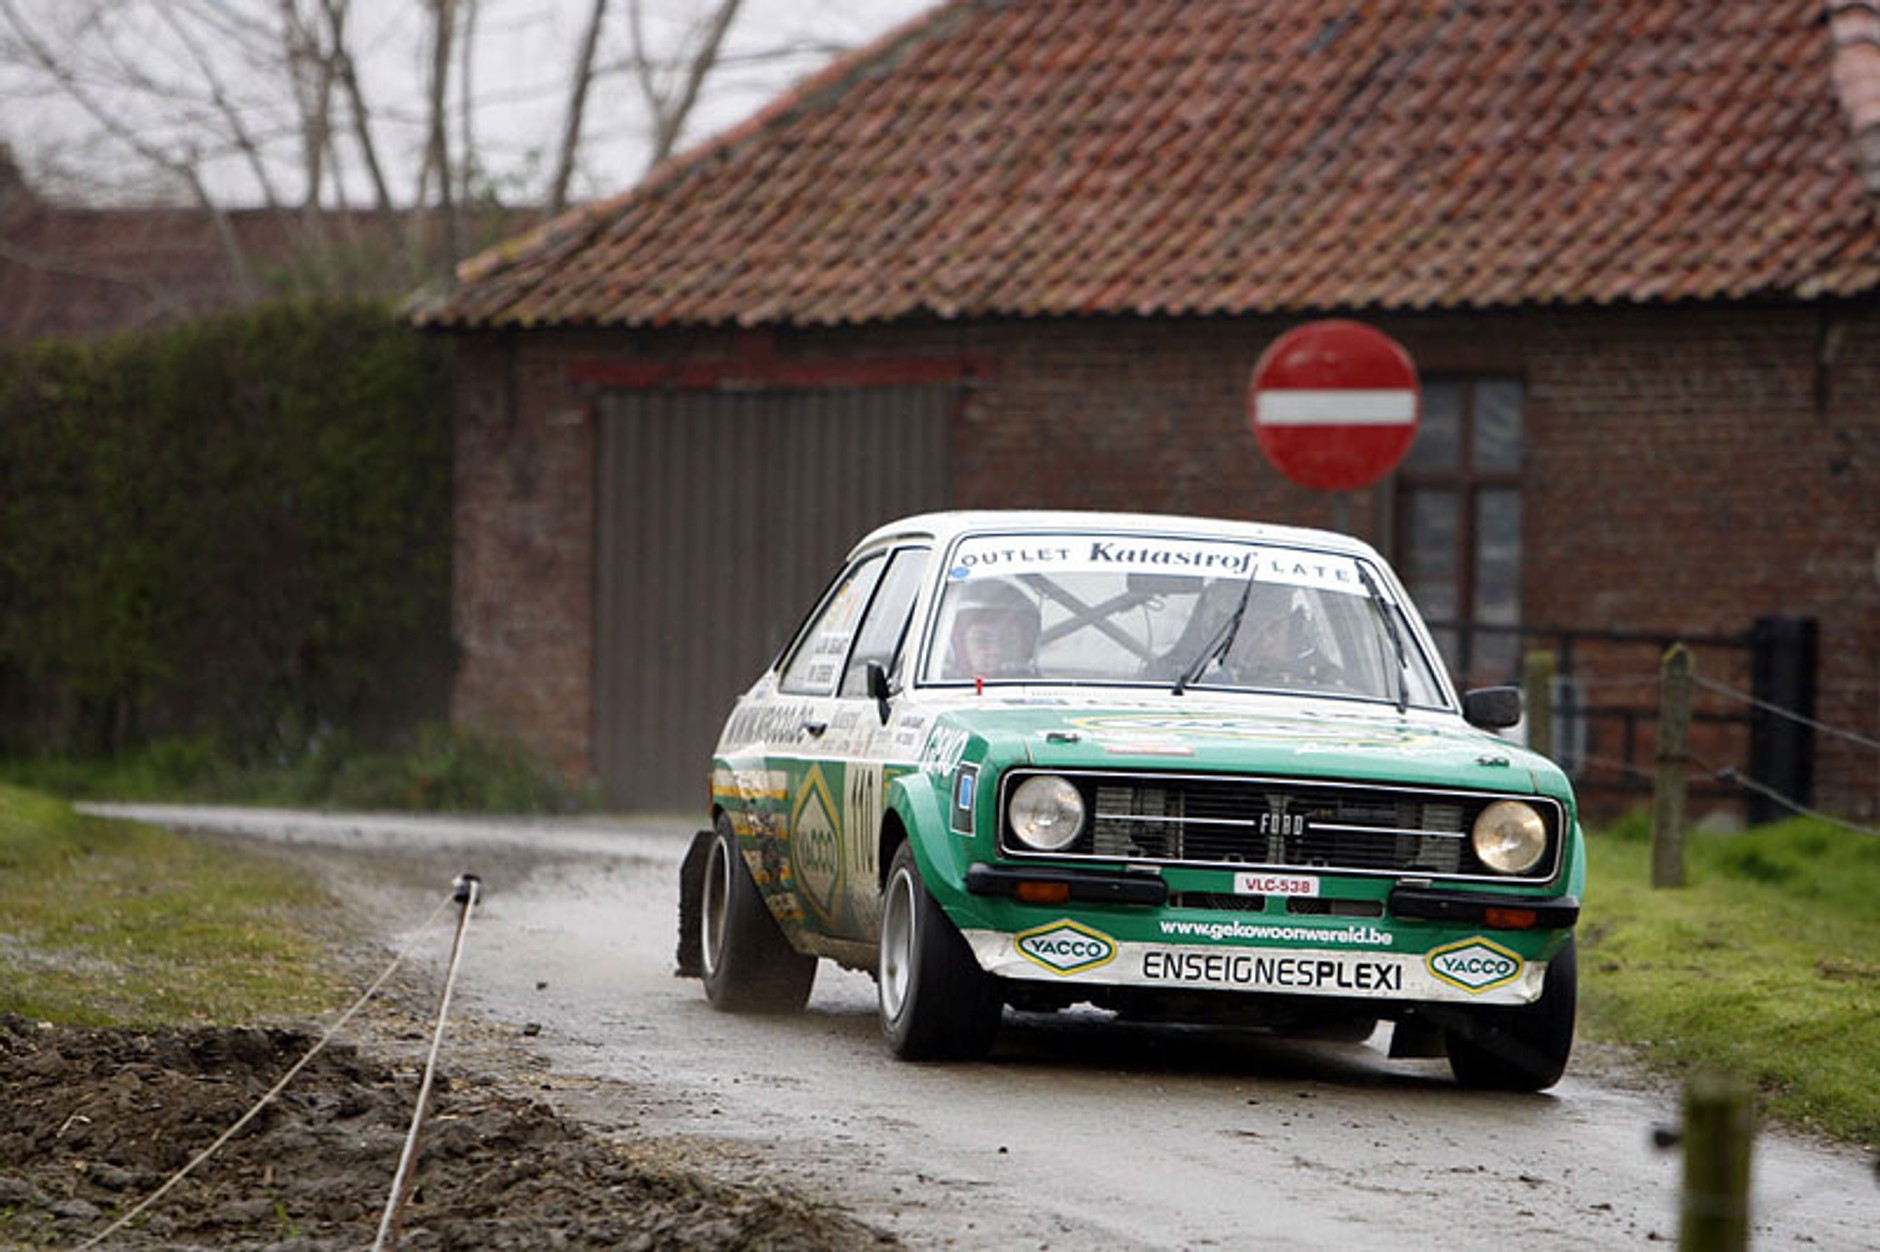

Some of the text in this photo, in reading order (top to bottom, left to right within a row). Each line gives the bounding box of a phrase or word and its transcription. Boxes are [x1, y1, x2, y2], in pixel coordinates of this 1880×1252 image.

[960, 542, 1350, 583] OUTLET Katastrof LATE
[1245, 878, 1311, 894] VLC-538
[1159, 920, 1393, 946] www.gekowoonwereld.be
[1031, 939, 1102, 957] YACCO
[1442, 957, 1511, 975] YACCO
